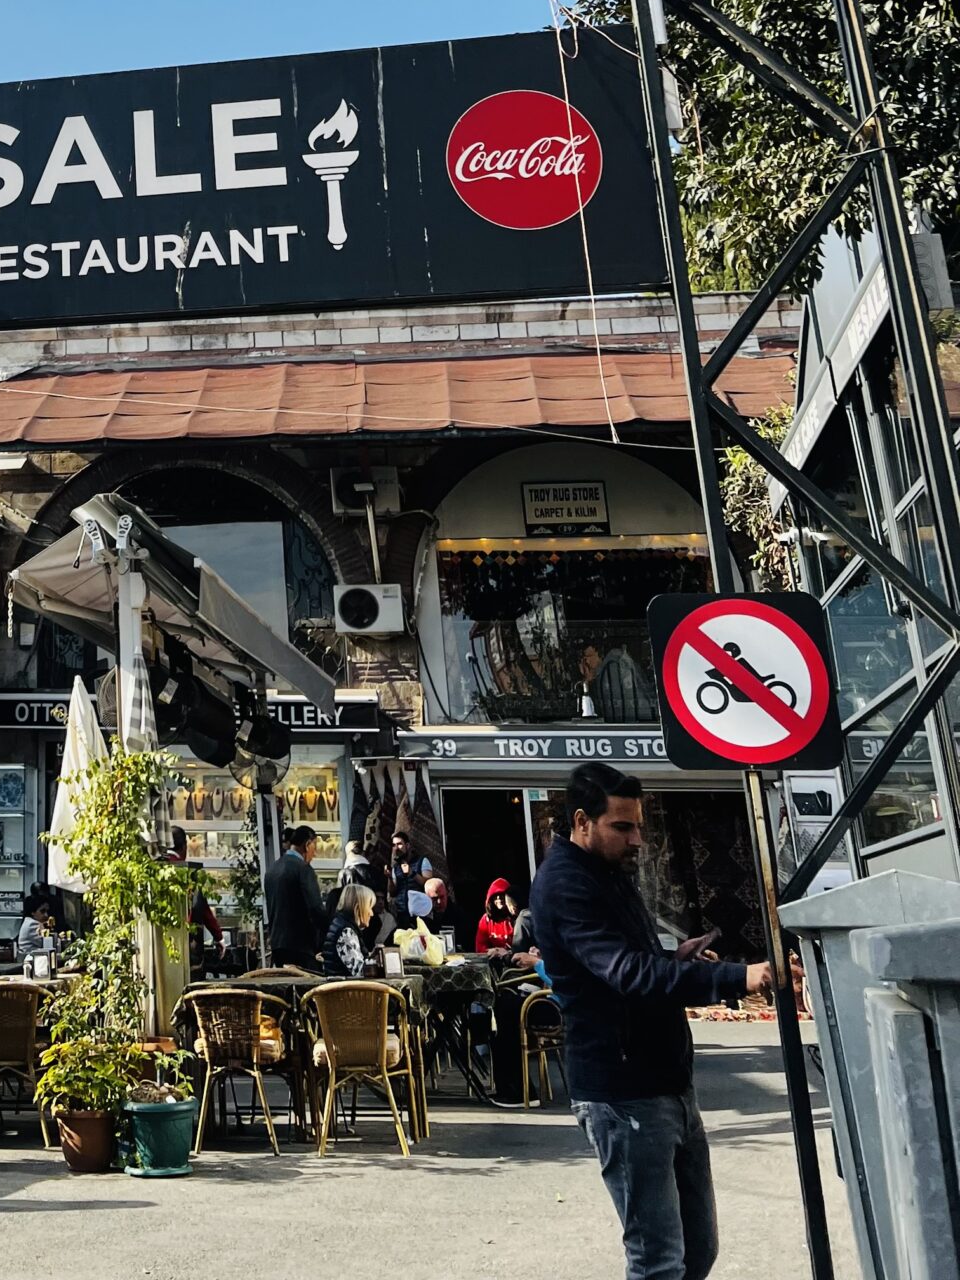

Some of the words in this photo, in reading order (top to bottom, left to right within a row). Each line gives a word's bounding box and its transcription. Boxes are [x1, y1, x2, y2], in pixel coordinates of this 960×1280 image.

[455, 135, 591, 182] Coca-Cola
[528, 488, 552, 503] TROY
[552, 488, 570, 502] RUG
[572, 487, 600, 501] STORE
[534, 507, 564, 519] CARPET
[431, 739, 457, 756] 39
[494, 739, 552, 756] TROY
[565, 739, 613, 756] RUG
